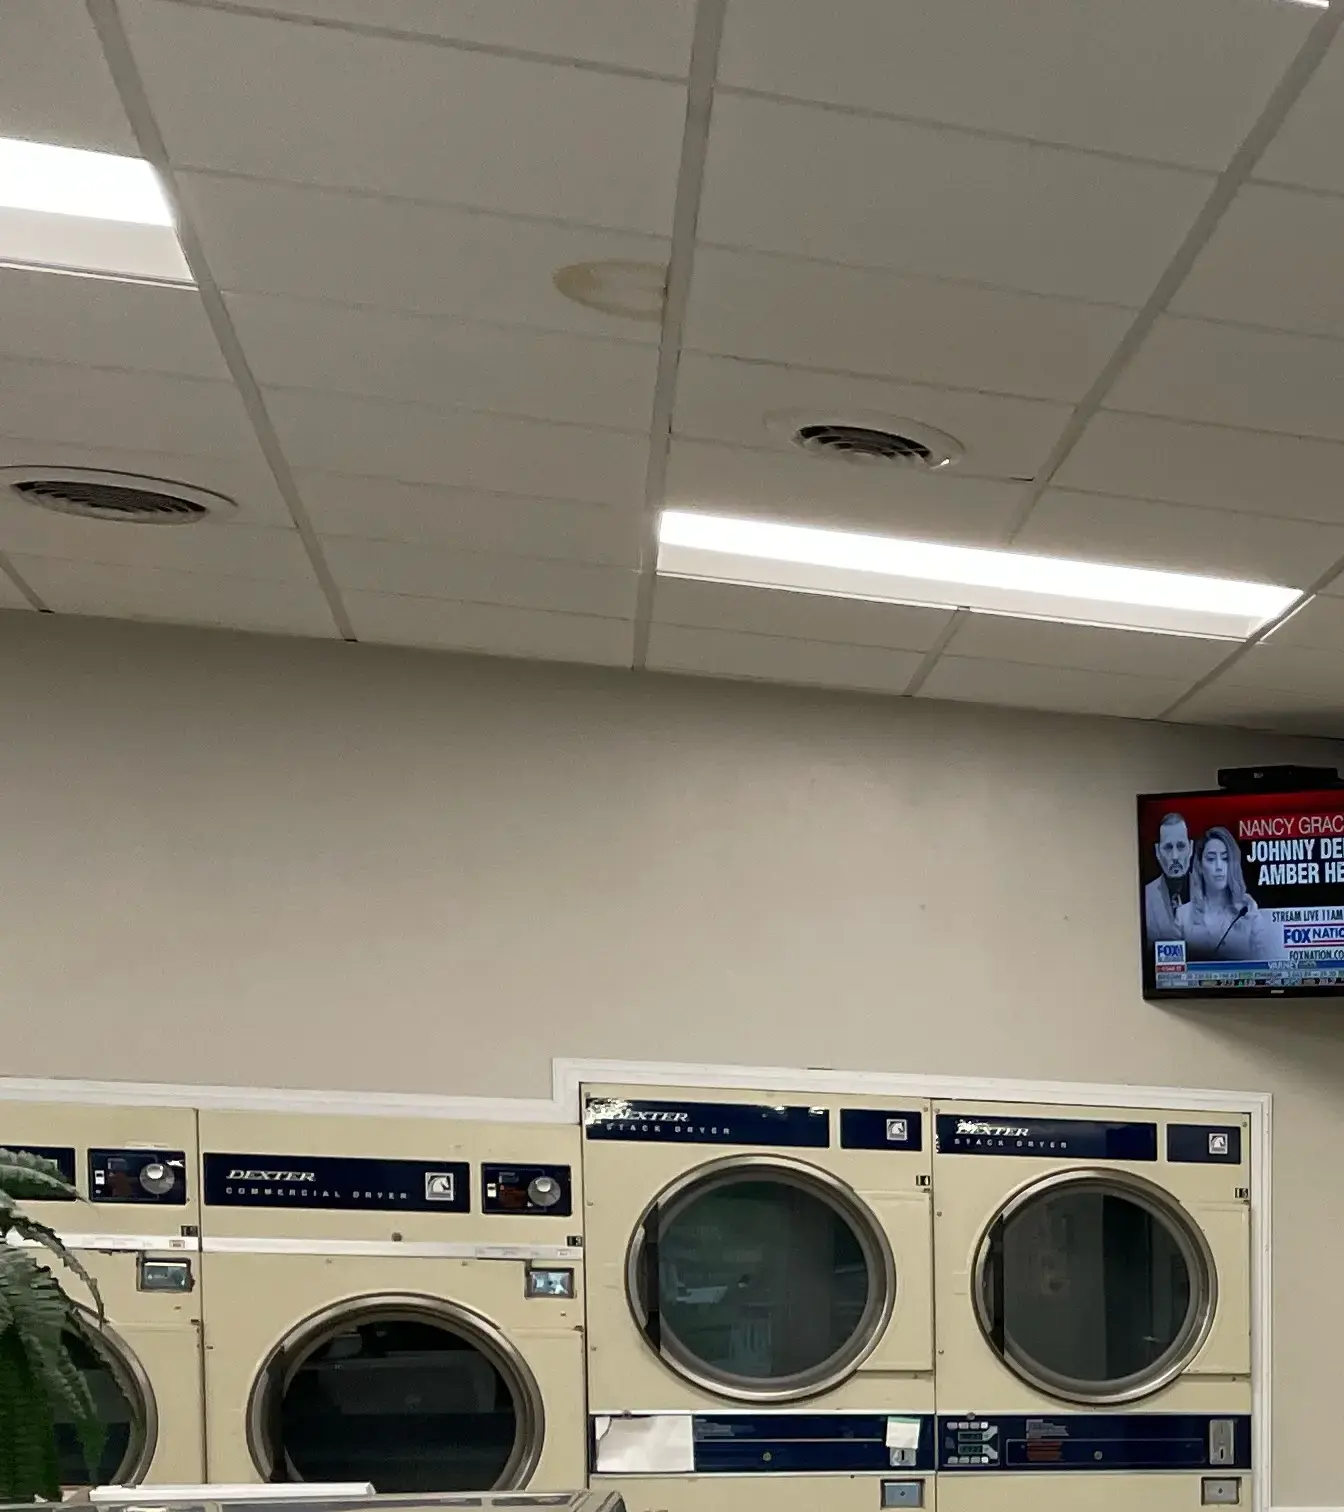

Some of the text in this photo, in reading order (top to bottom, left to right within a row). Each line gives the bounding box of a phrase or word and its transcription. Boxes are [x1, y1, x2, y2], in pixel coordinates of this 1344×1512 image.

[1239, 816, 1295, 838] NANCY
[1246, 838, 1316, 863] JOHNNY
[1257, 862, 1320, 886] AMBER
[1272, 910, 1301, 922] STREAM
[1303, 909, 1319, 922] LIVE
[1322, 908, 1344, 921] 11AM
[1283, 927, 1312, 944] FOX
[225, 1169, 317, 1182] DEXTER
[225, 1186, 408, 1200] COMMERCIAL DRYER
